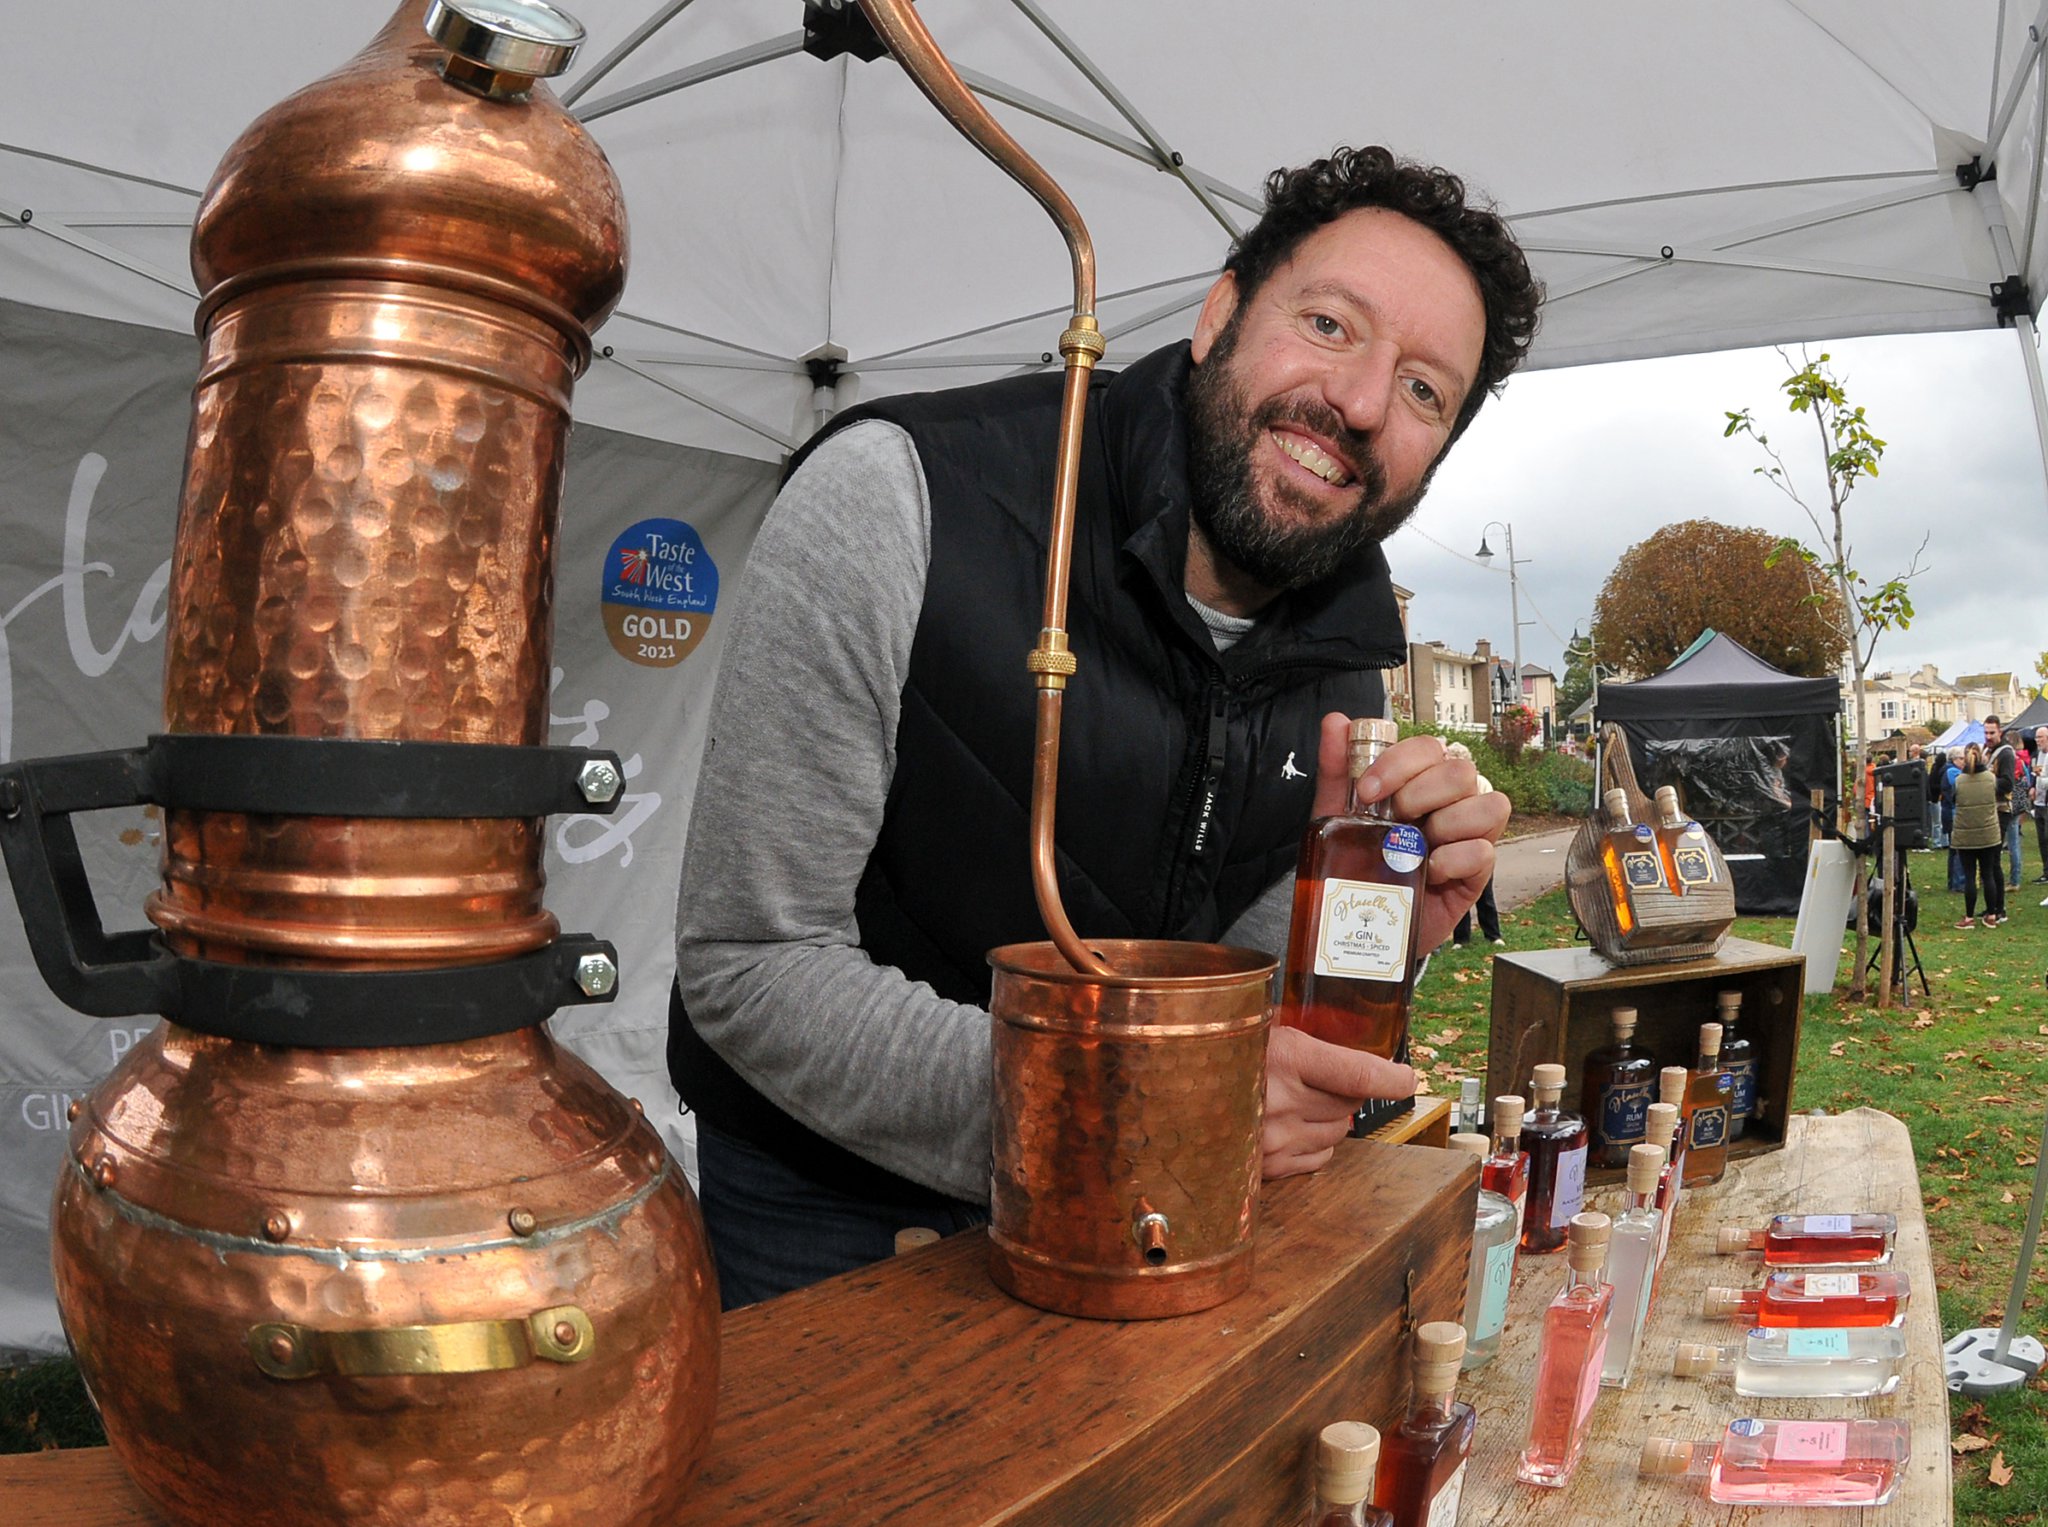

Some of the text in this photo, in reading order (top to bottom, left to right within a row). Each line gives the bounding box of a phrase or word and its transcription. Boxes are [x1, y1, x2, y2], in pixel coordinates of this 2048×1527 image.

[646, 533, 696, 565] Taste
[646, 563, 694, 593] West
[611, 585, 707, 608] South West England
[622, 614, 691, 640] GOLD
[637, 643, 675, 659] 2021
[1195, 792, 1214, 851] JACK WILLS
[1399, 827, 1419, 840] Taste
[1399, 837, 1418, 849] West
[1355, 930, 1373, 941] GIN
[1333, 940, 1366, 949] CHRISTMAS
[1733, 1089, 1746, 1098] UM
[1626, 1112, 1643, 1121] RUM
